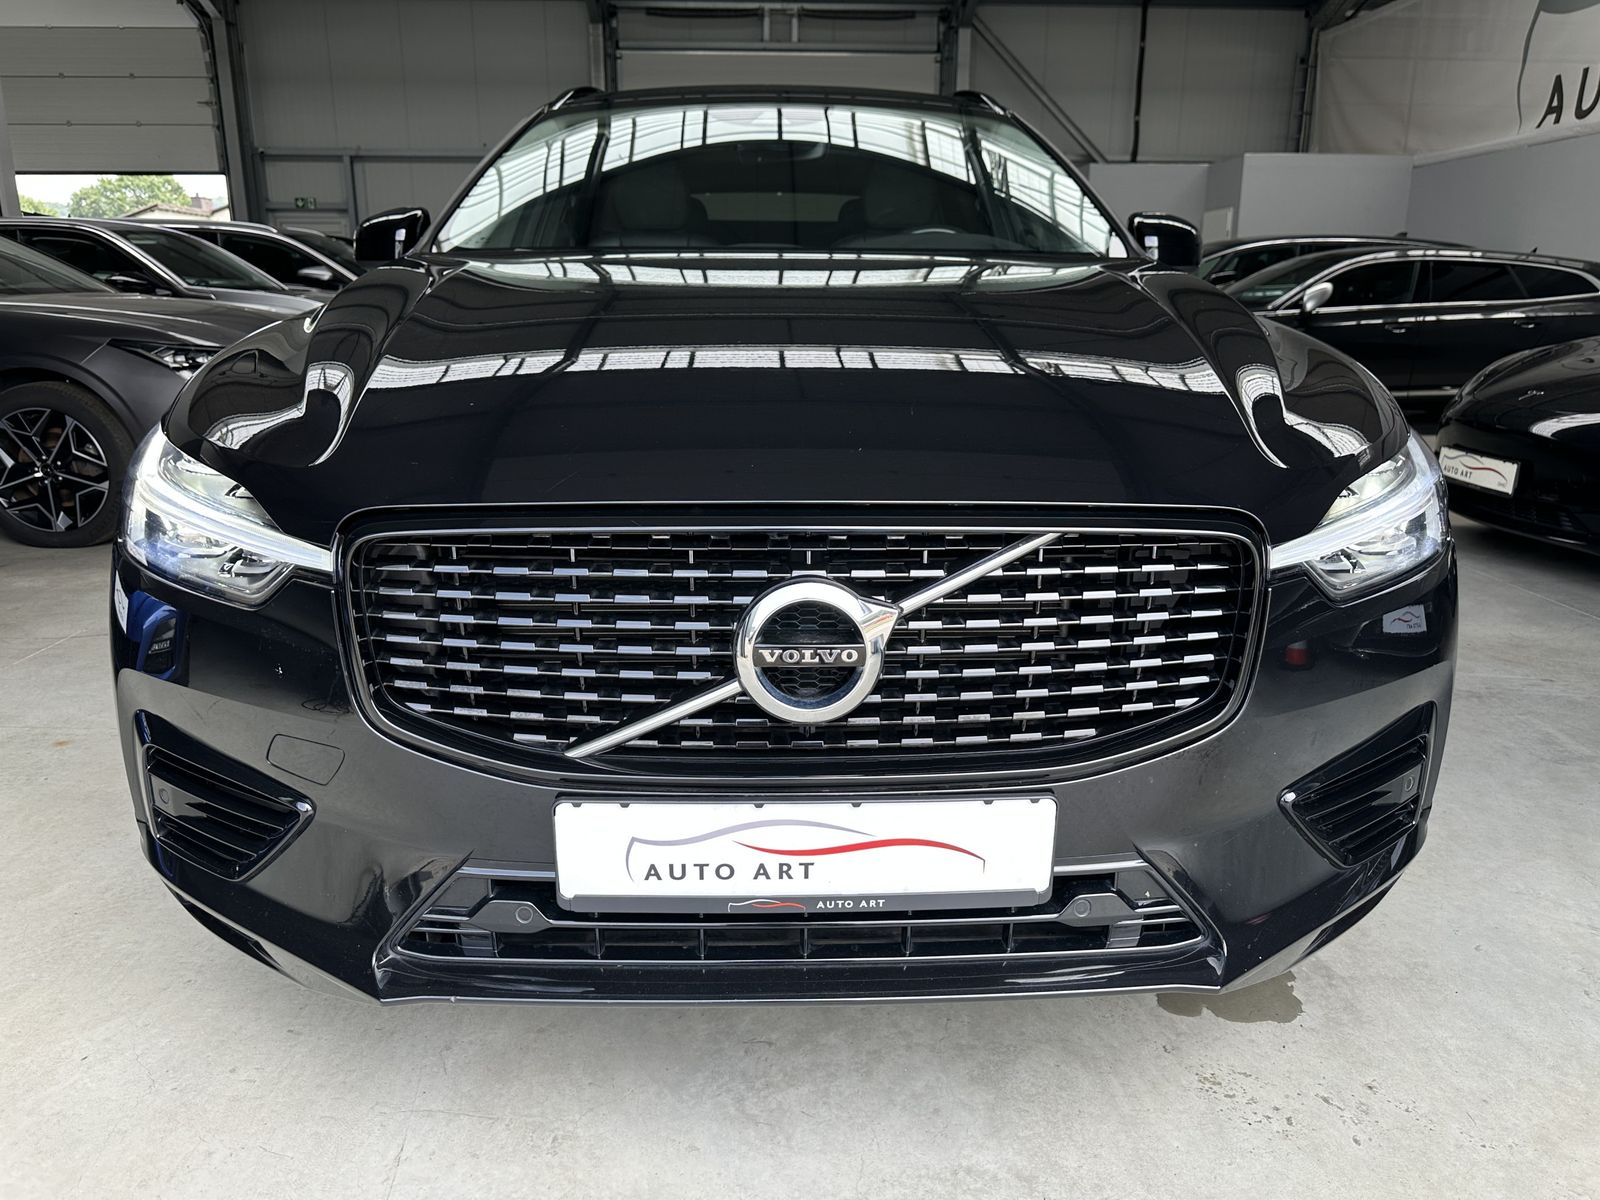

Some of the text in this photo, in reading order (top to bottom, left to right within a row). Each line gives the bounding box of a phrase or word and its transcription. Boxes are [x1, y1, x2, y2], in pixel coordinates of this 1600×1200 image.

[1443, 464, 1473, 480] AUTO ART
[758, 649, 859, 664] VOLVO
[644, 862, 815, 881] AUTO ART
[816, 899, 886, 909] AUTO ART
